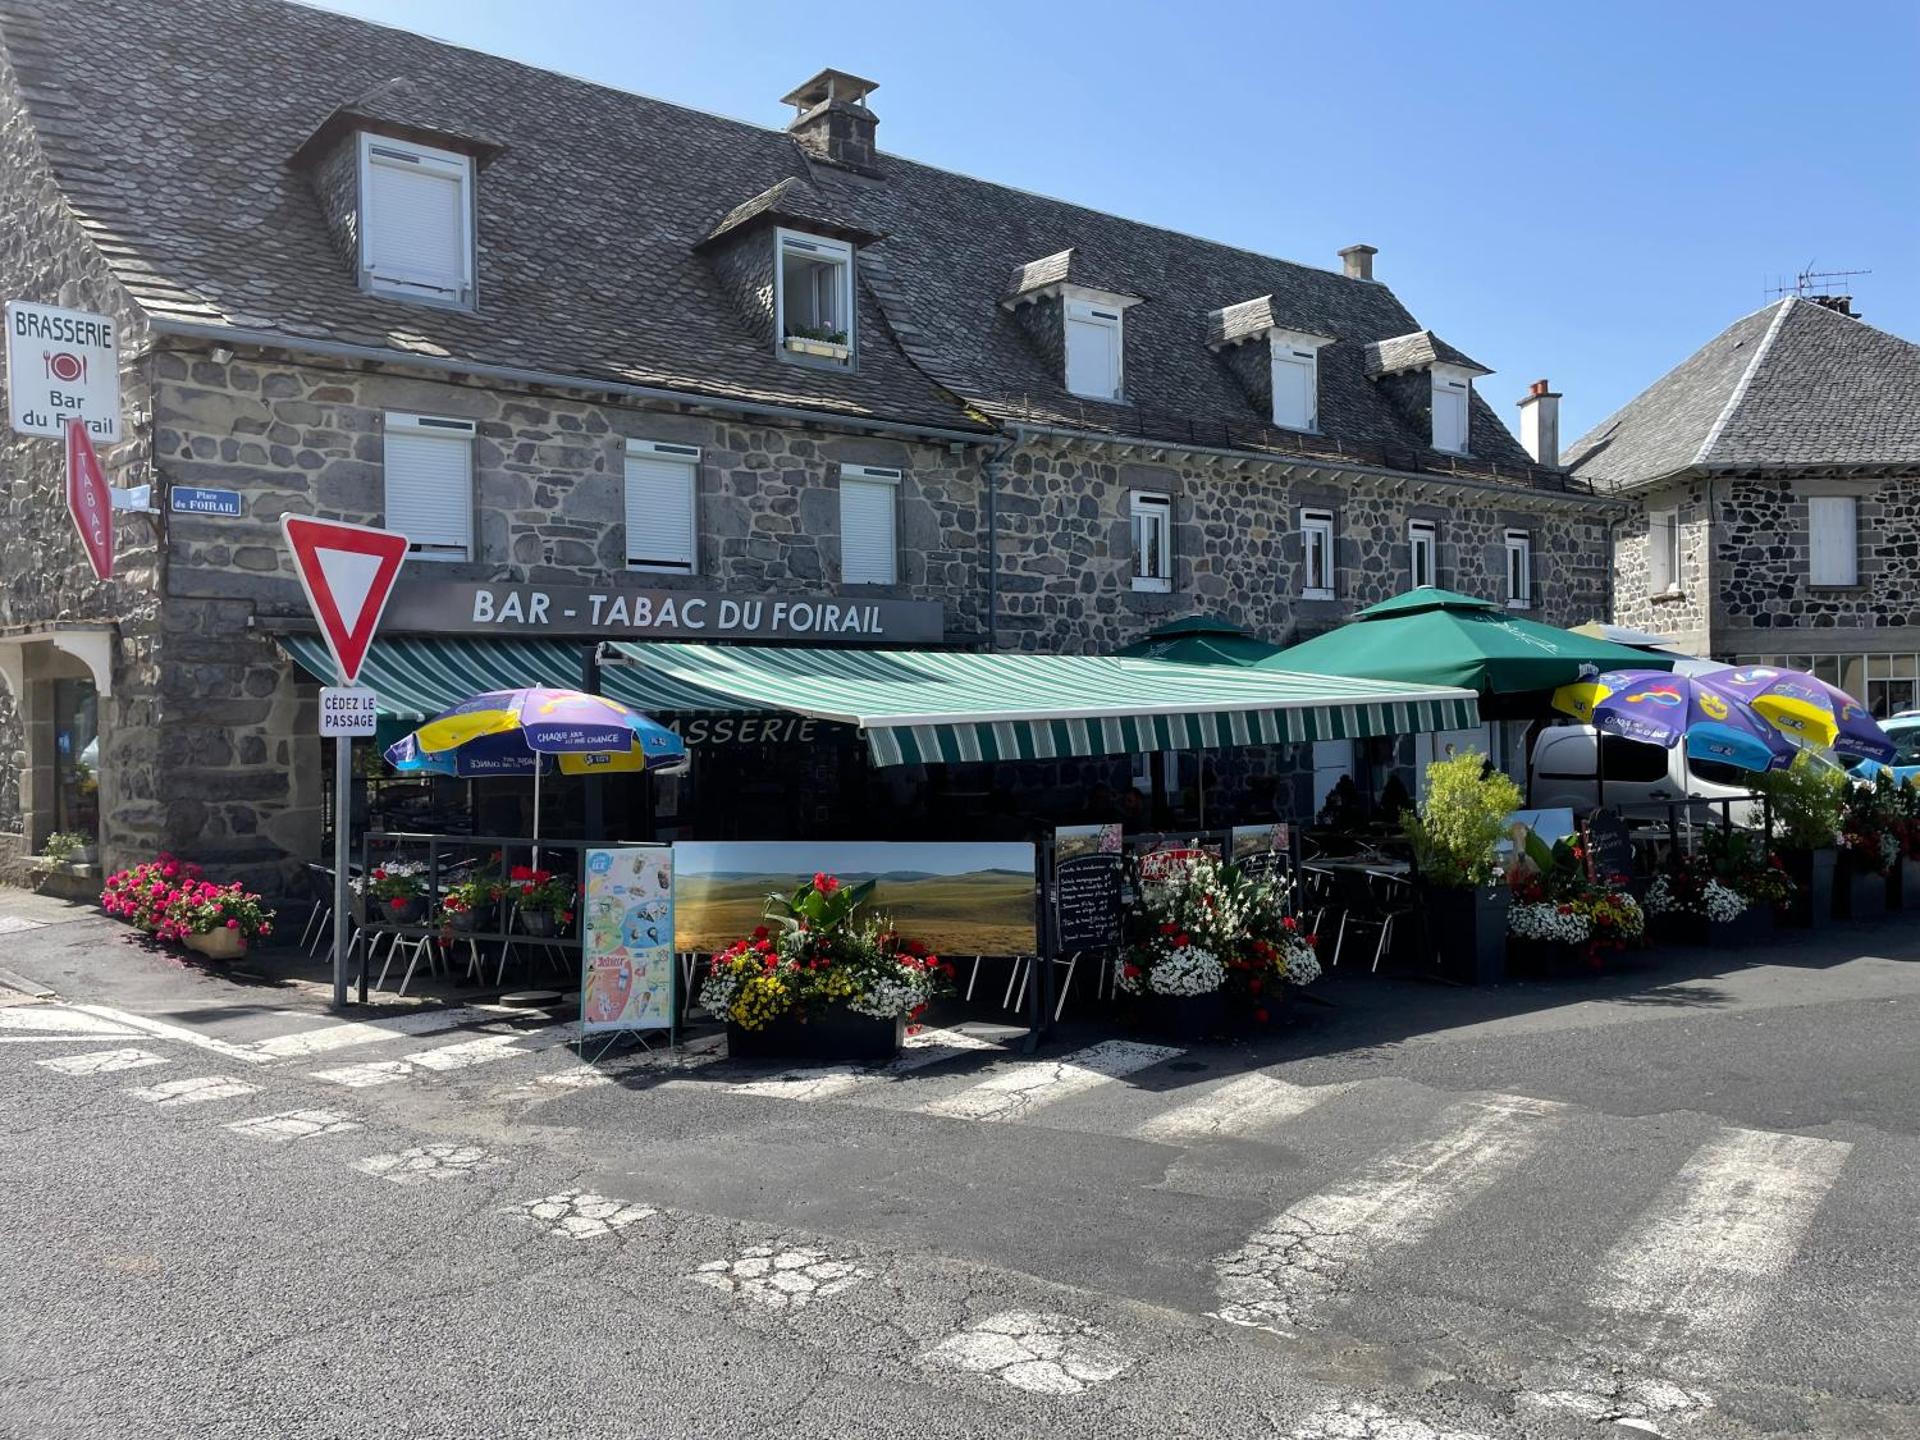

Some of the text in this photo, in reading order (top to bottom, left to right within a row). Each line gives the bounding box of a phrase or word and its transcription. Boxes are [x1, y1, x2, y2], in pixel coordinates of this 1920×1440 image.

[15, 310, 113, 349] BRASSERIE
[49, 389, 86, 409] Bar
[22, 409, 113, 435] du Frail
[77, 452, 104, 546] TABAC
[196, 490, 217, 501] Place
[189, 499, 237, 513] FOIRAIL
[471, 589, 551, 625] BAR
[588, 593, 706, 629] TABAC
[717, 599, 763, 631] DU
[771, 601, 884, 635] FOIRAIL
[325, 694, 375, 710] CÉDEZ LE
[325, 714, 374, 728] PASSAGE
[536, 731, 568, 743] CHAQUE
[586, 734, 619, 744] CHANCE
[667, 717, 816, 745] ASSERIE
